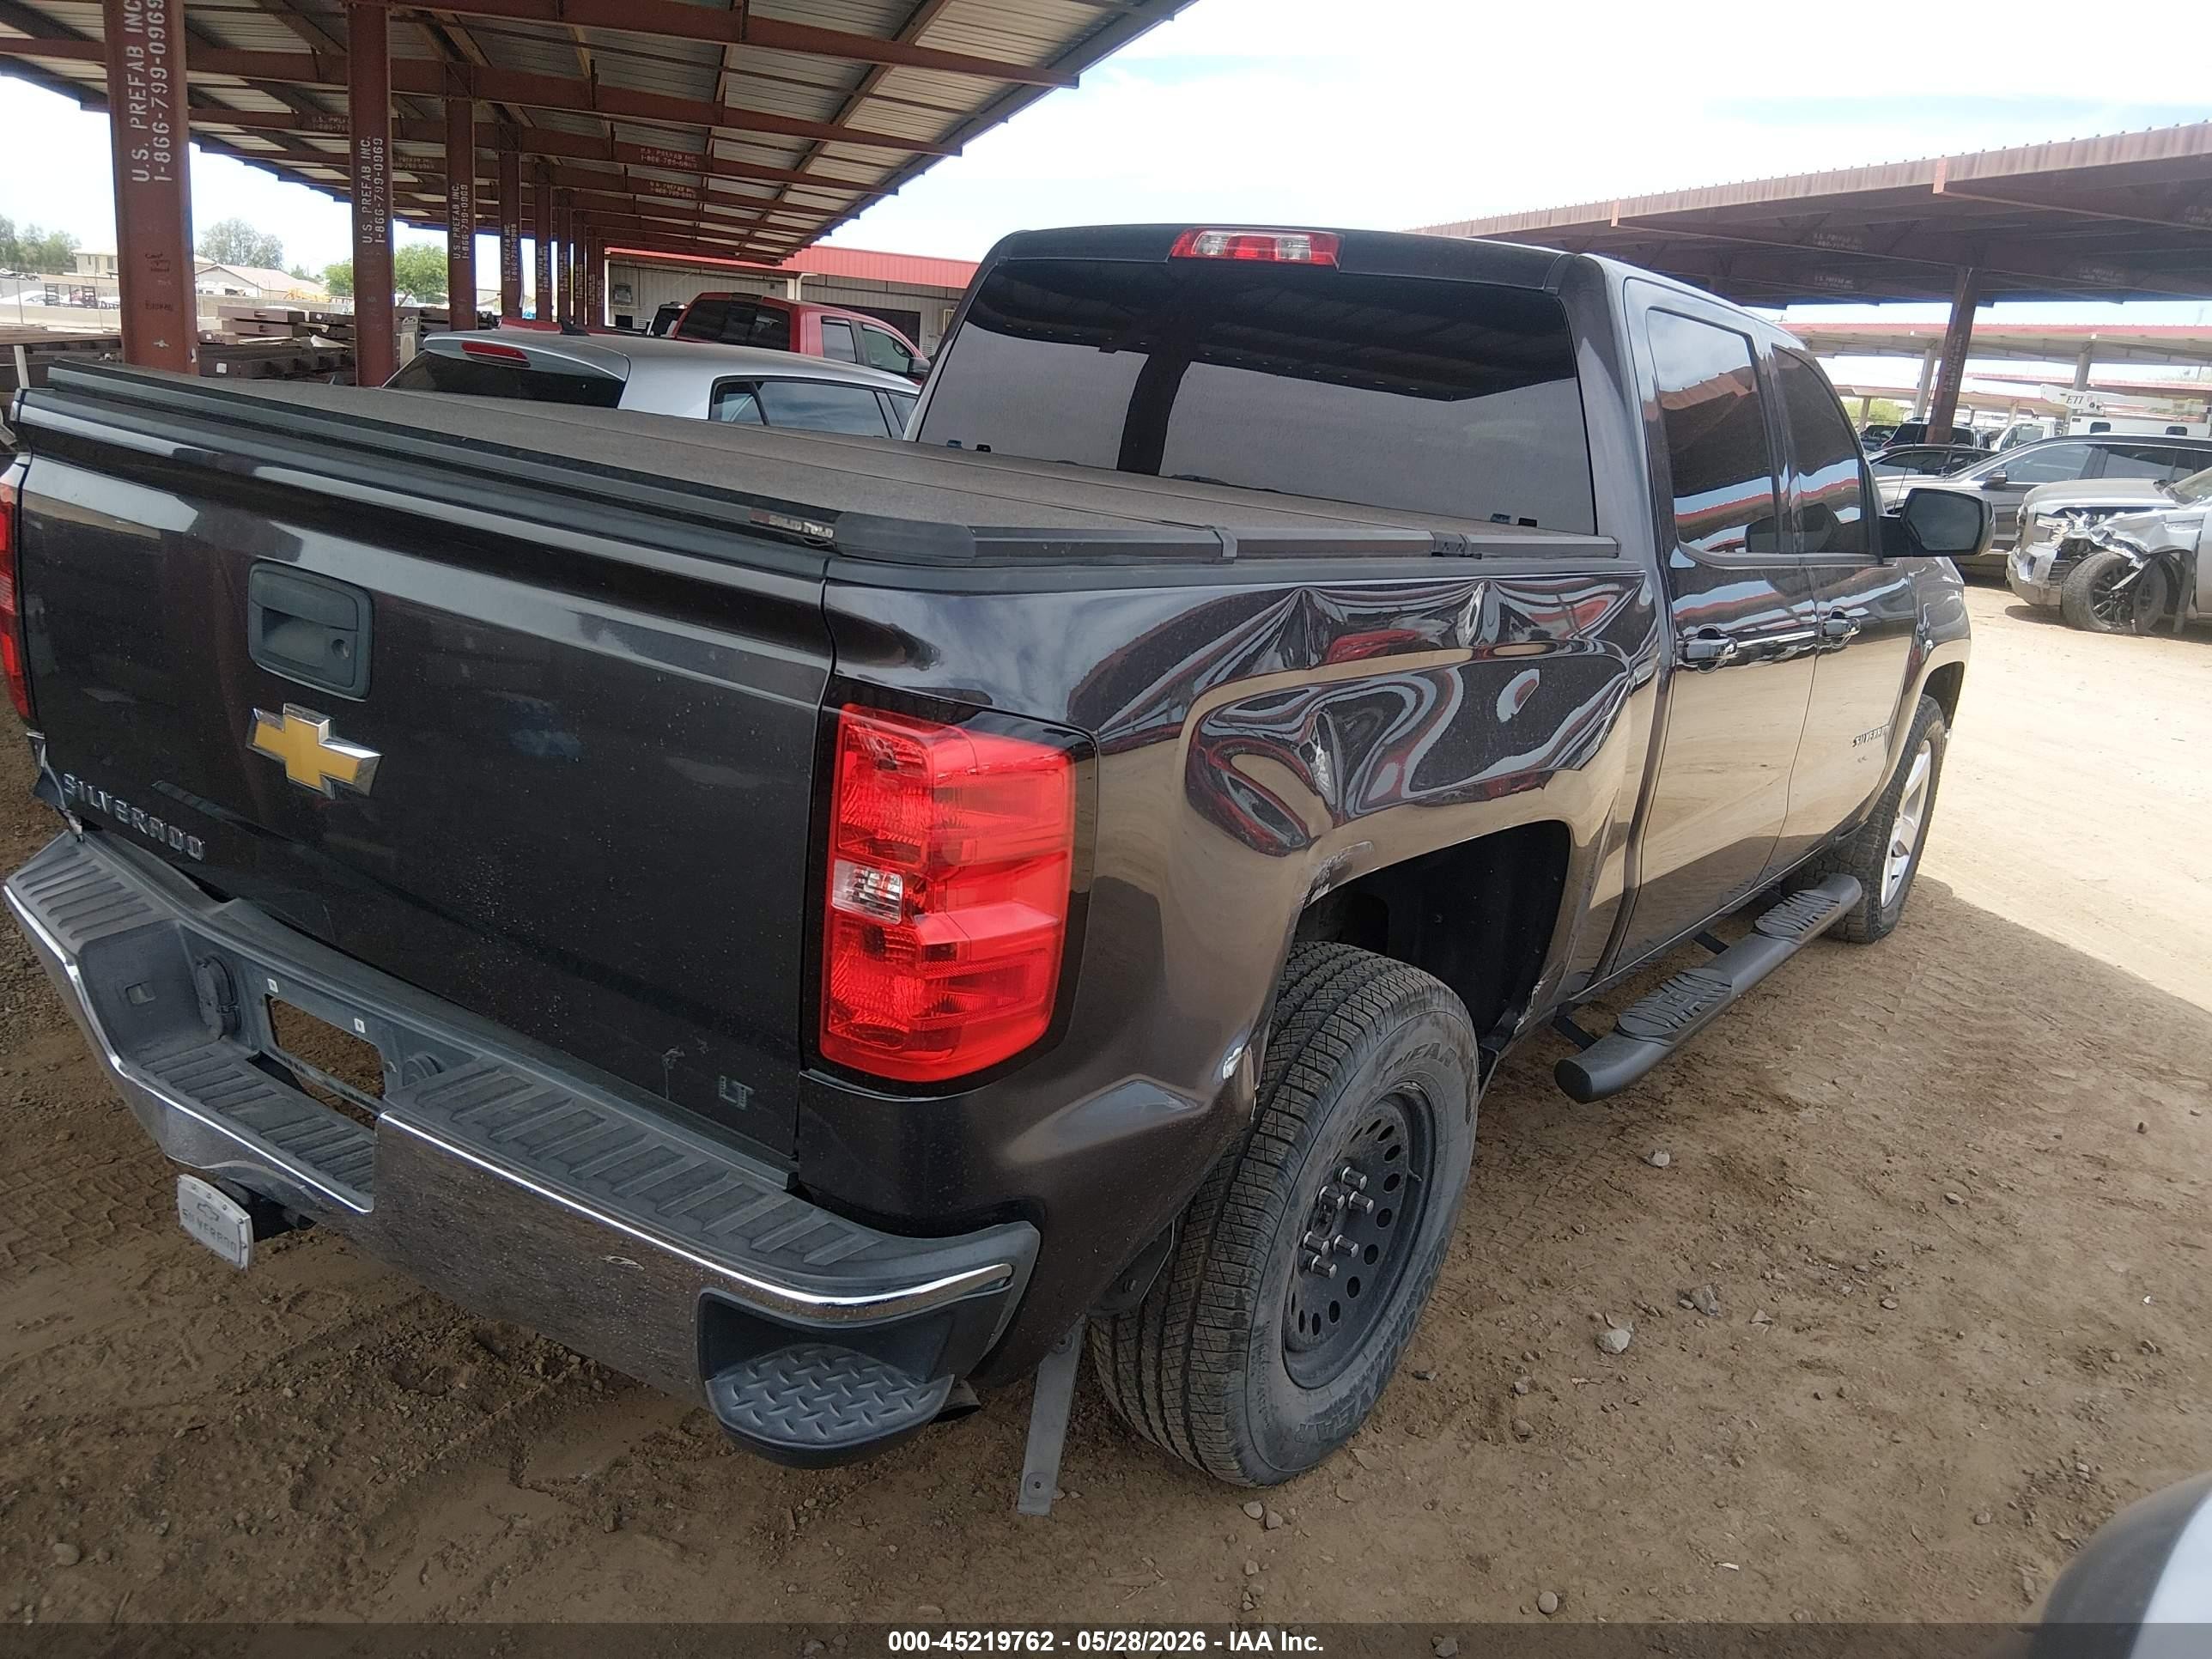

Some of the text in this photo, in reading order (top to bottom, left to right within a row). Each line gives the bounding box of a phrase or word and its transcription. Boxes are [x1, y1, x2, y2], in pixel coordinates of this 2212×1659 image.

[126, 46, 149, 129] PREFAB
[146, 0, 173, 181] 1-866-799-0969
[131, 143, 150, 182] U.S.
[360, 136, 374, 244] U.S. PREFAB INC.
[373, 137, 386, 243] 1-866-799-0969
[452, 204, 461, 238] PREFAB
[64, 773, 206, 860] SILVERADO
[720, 1075, 755, 1110] LT
